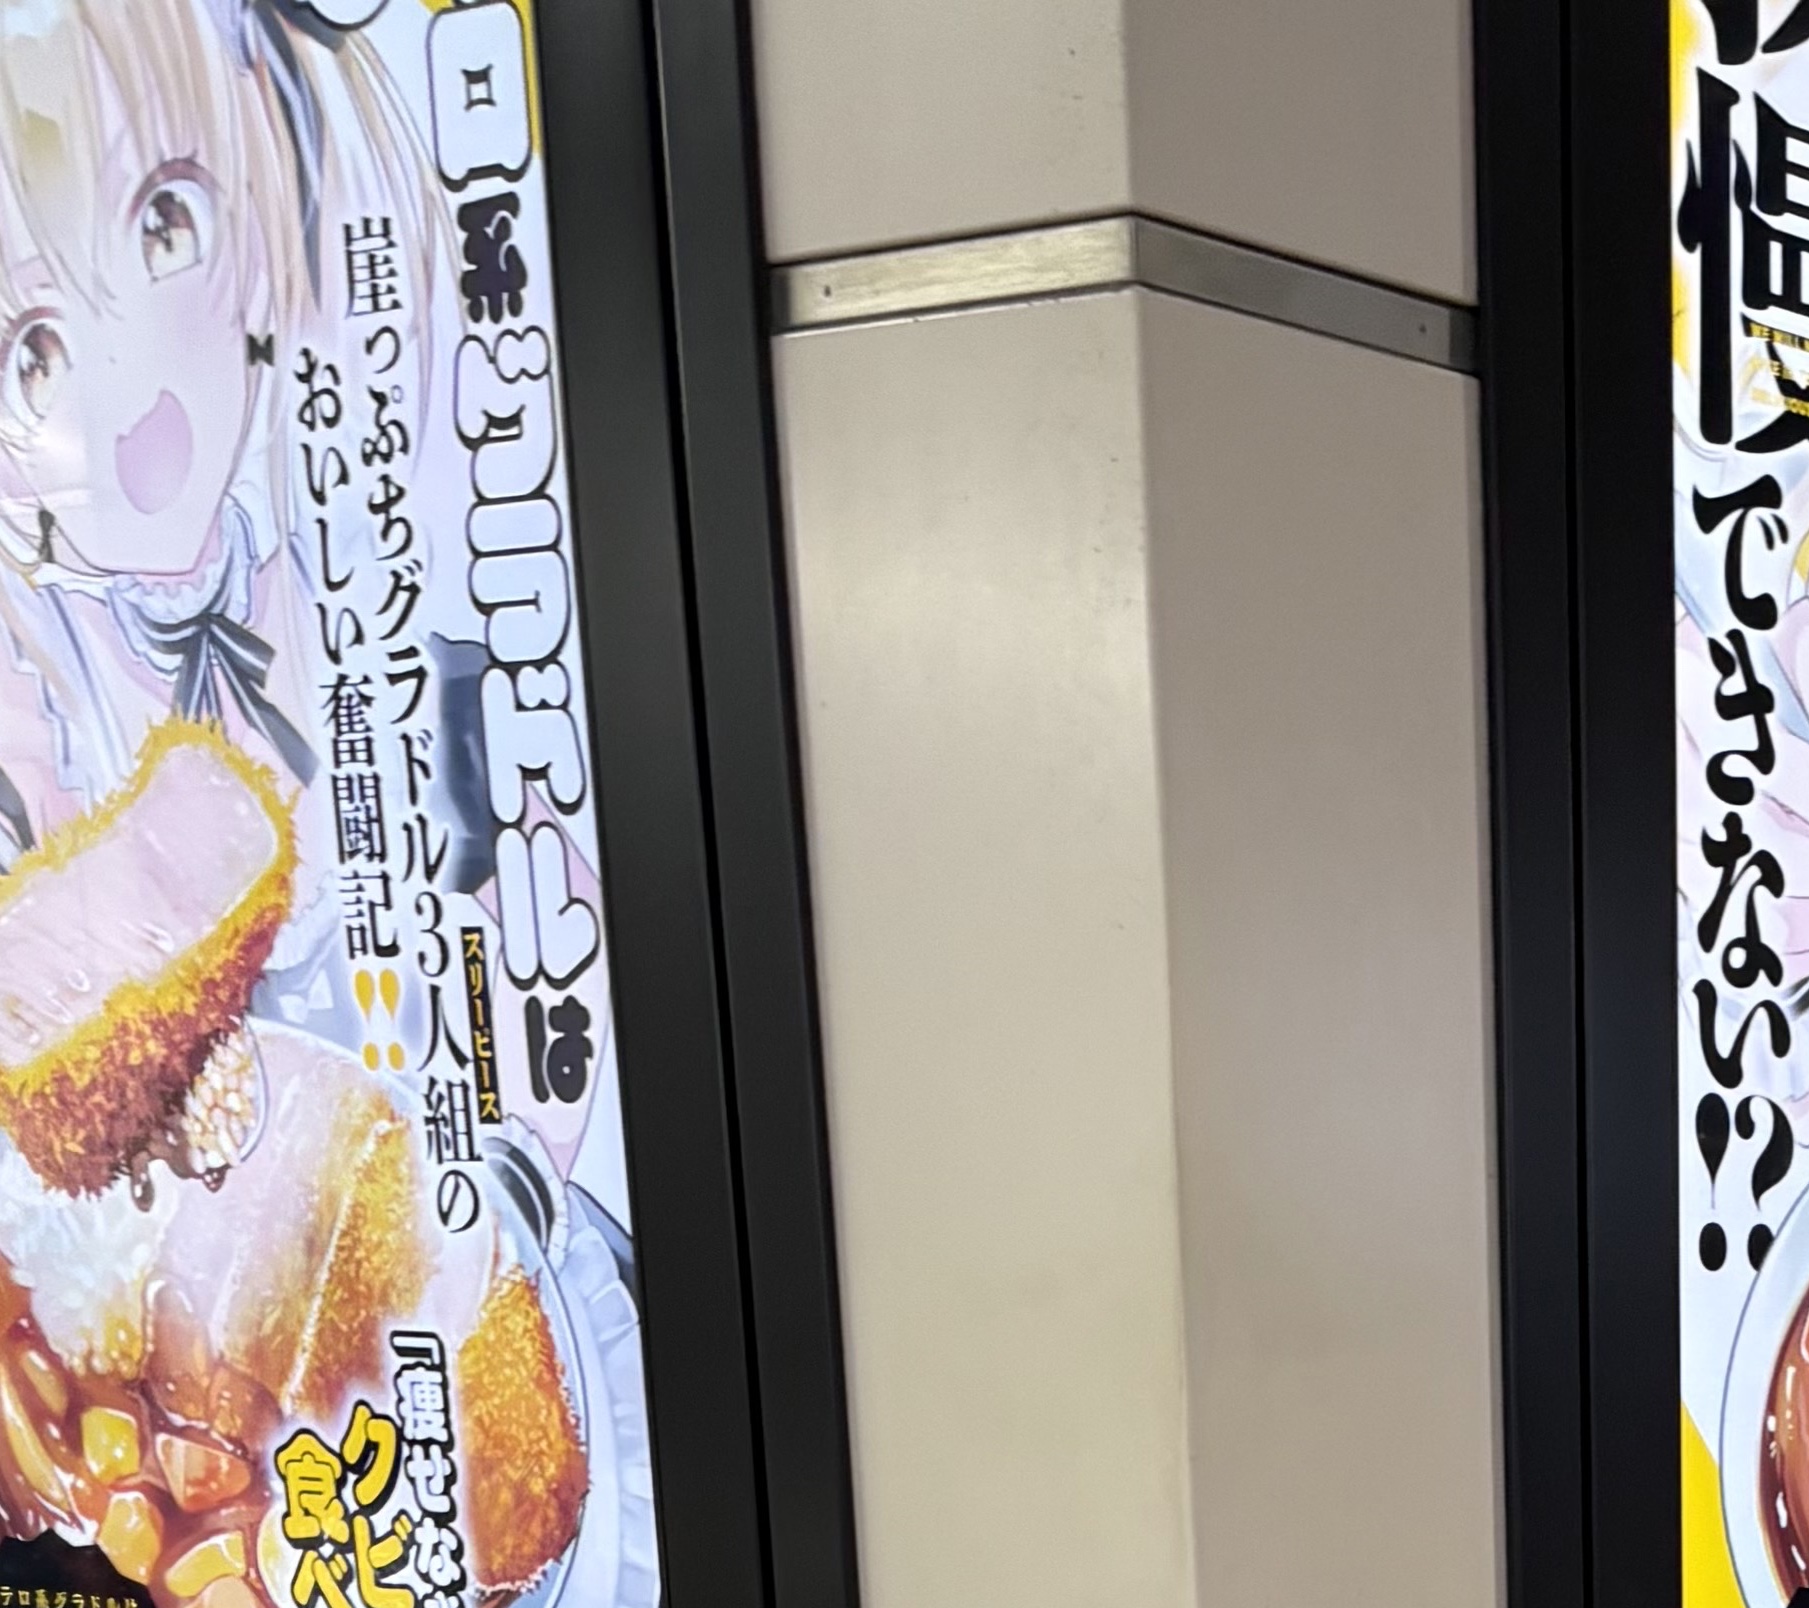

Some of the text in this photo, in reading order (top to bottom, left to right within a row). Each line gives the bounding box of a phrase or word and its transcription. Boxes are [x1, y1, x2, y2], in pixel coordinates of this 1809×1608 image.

[427, 0, 602, 1104] ロ系グラドルは
